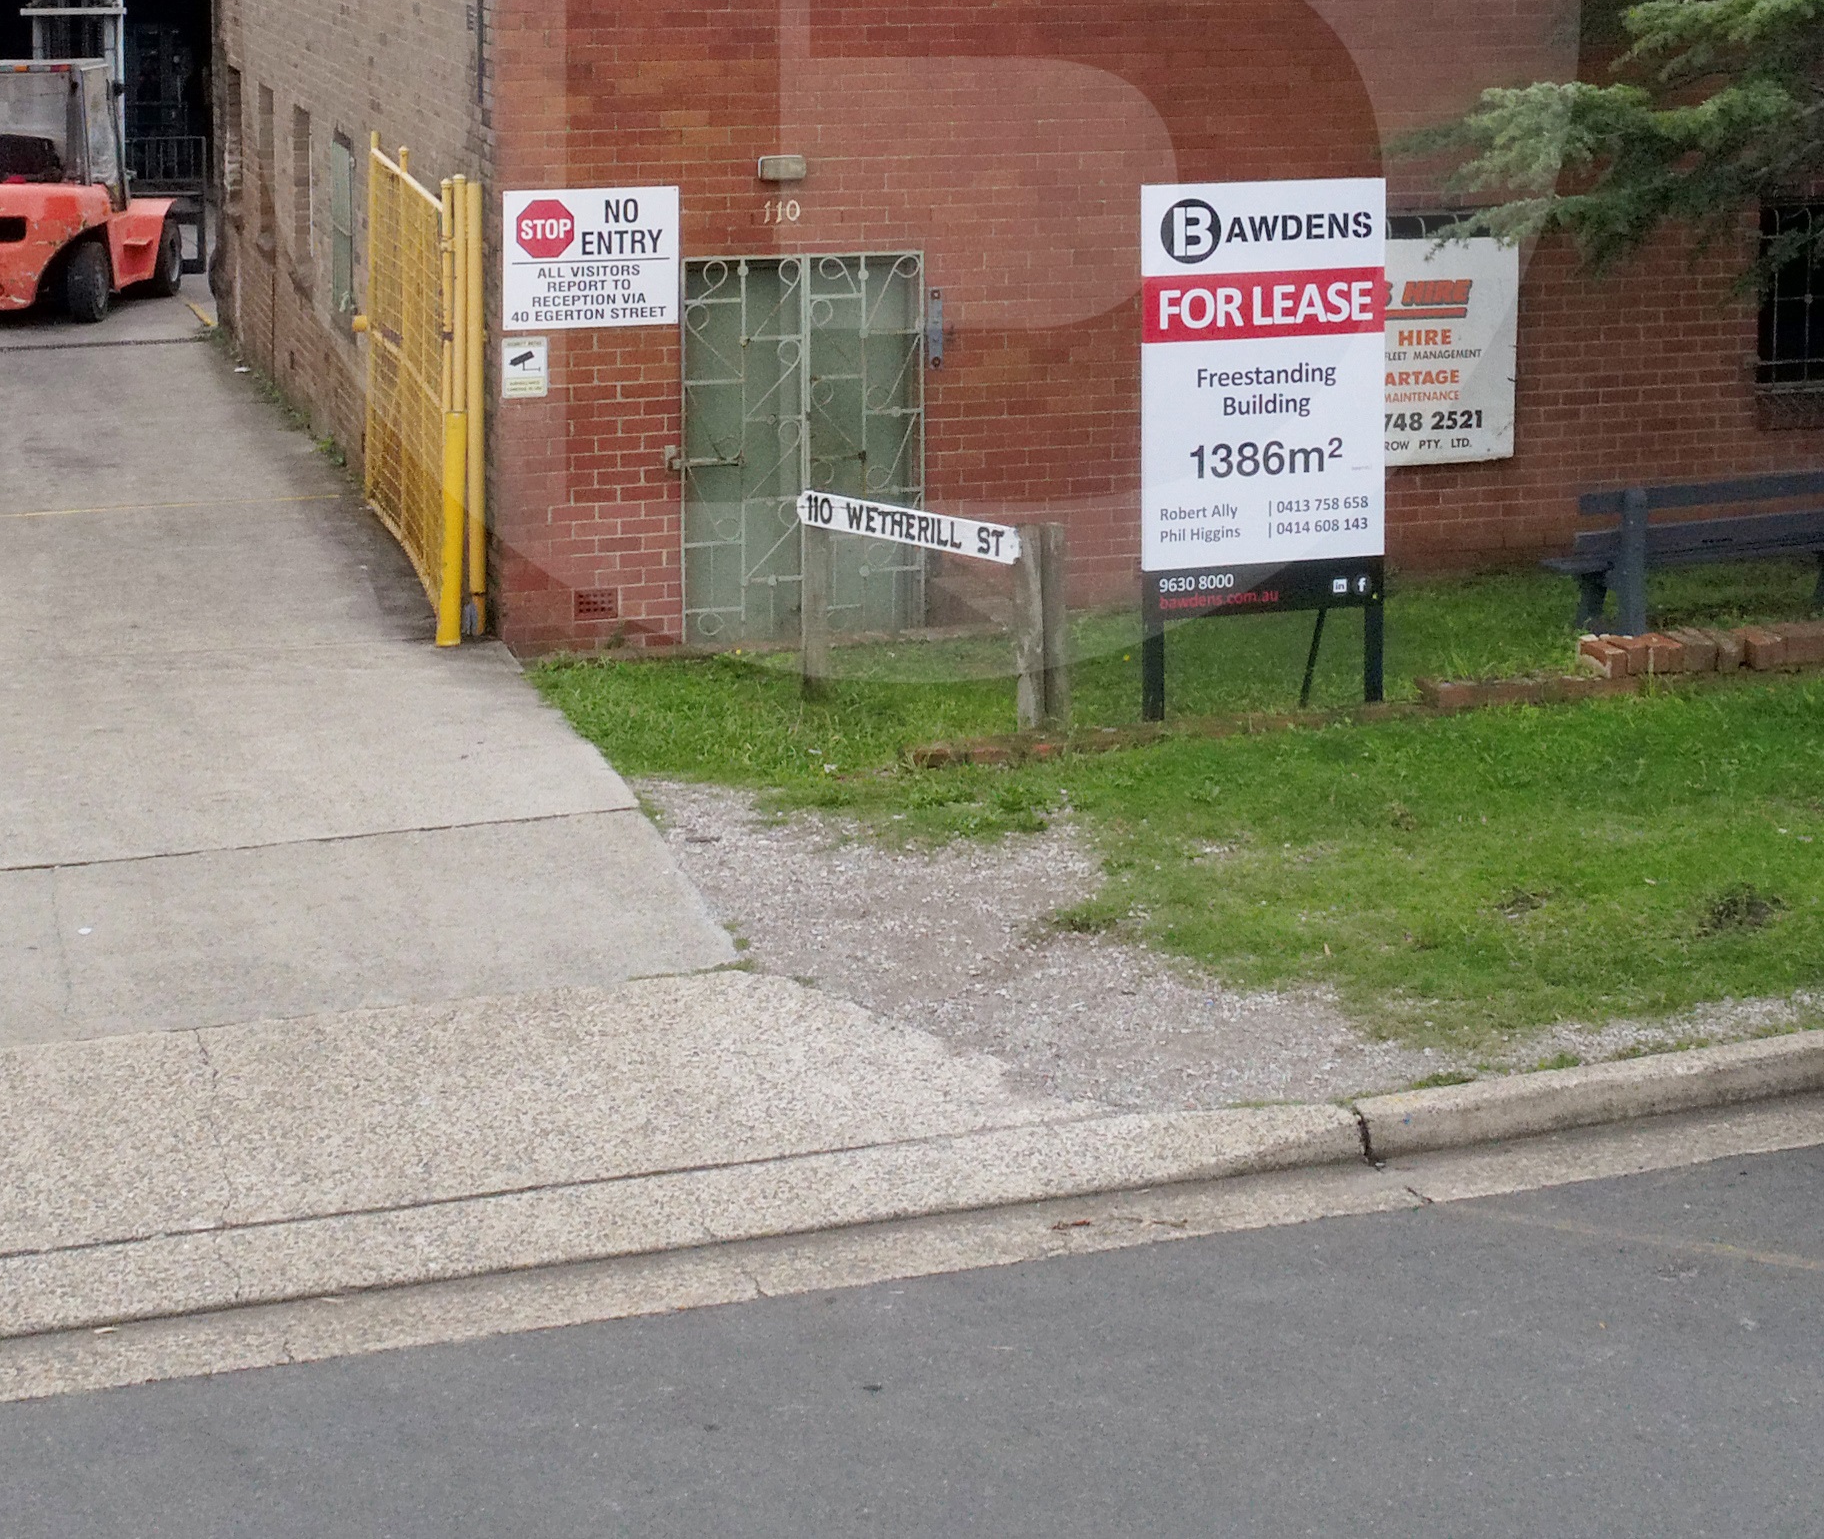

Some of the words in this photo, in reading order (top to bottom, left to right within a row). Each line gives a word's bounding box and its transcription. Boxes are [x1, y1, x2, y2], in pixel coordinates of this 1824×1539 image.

[604, 198, 639, 224] NO
[764, 199, 801, 224] 110
[520, 218, 572, 241] STOP
[581, 229, 663, 256] ENTRY
[537, 268, 565, 279] ALL
[571, 264, 640, 277] VISITORS
[547, 281, 604, 293] REPORT
[612, 278, 631, 291] TO
[1402, 279, 1472, 307] HIRE
[532, 294, 616, 308] RECEPTION
[622, 292, 646, 304] VIA
[1160, 287, 1244, 330] FOR
[1252, 281, 1373, 326] LEASE
[511, 311, 529, 323] 40
[535, 308, 604, 322] EGERTON
[610, 306, 666, 319] STREET
[1398, 329, 1452, 347] HIRE
[1413, 348, 1482, 361] MANAGEMENT
[1197, 362, 1336, 388] Freestanding
[1385, 369, 1460, 386] ARTAGE
[1223, 393, 1311, 417] Building
[1431, 410, 1482, 430] 2521
[1160, 506, 1207, 521] Robert
[1211, 503, 1238, 519] Ally
[1276, 500, 1310, 513] 0413
[1314, 497, 1340, 510] 758
[1343, 495, 1369, 508] 658
[806, 494, 833, 524] 110
[846, 502, 962, 549] WETHERILL
[977, 526, 1005, 557] ST
[1160, 528, 1186, 543] Phil
[1190, 525, 1241, 543] Higgins
[1276, 521, 1310, 535] 0414
[1314, 519, 1339, 532] 608
[1344, 517, 1368, 530] 143
[1159, 577, 1195, 593] 9630
[1198, 573, 1234, 590] 8000
[1159, 590, 1279, 610] bawdens.com.au
